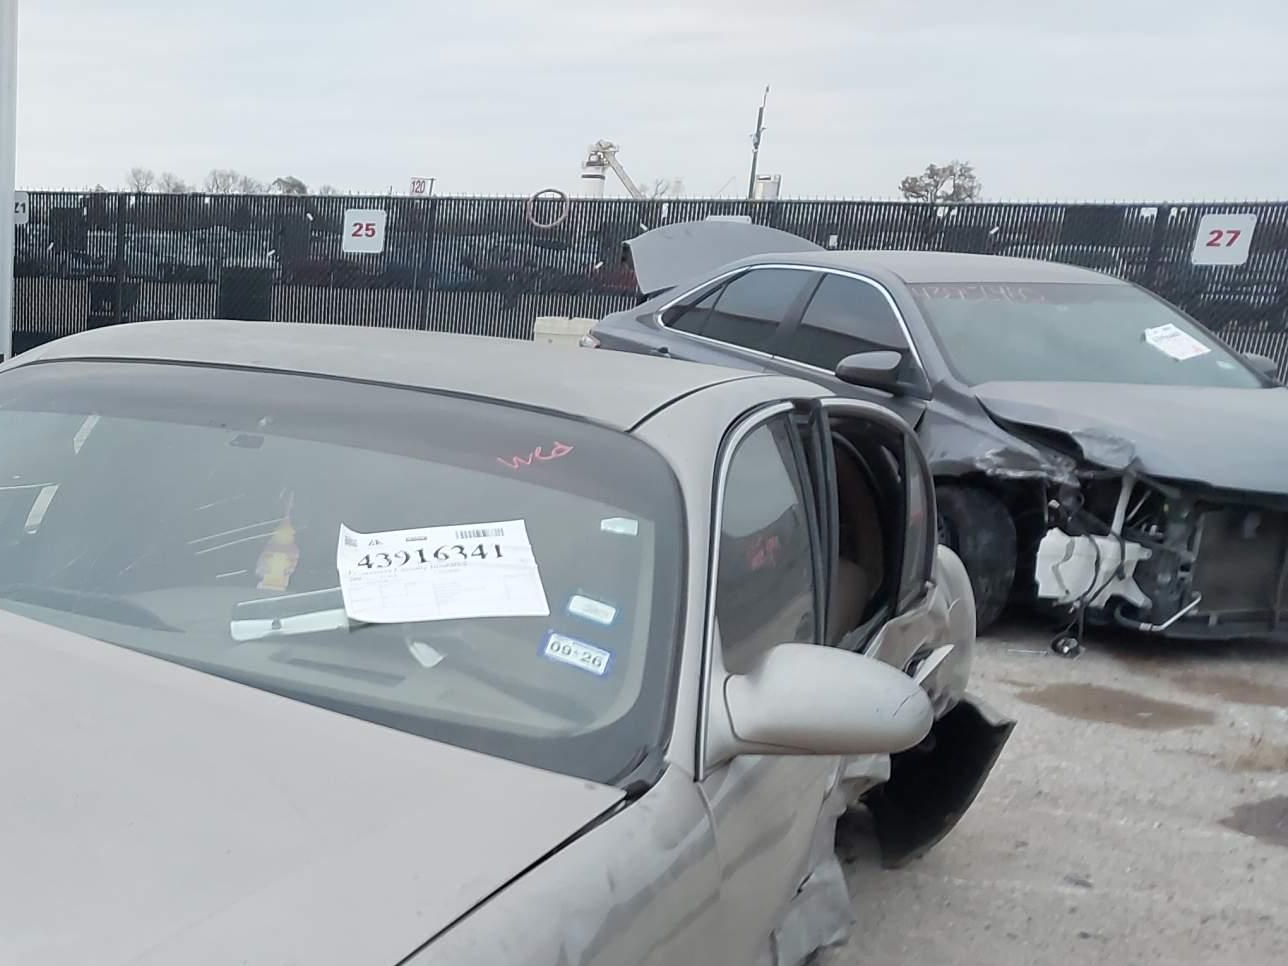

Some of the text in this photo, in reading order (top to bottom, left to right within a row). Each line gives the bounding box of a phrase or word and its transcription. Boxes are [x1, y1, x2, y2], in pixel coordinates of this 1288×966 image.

[410, 179, 426, 194] 120
[350, 222, 377, 239] 25
[1205, 228, 1242, 248] 27
[357, 543, 504, 569] 43916341
